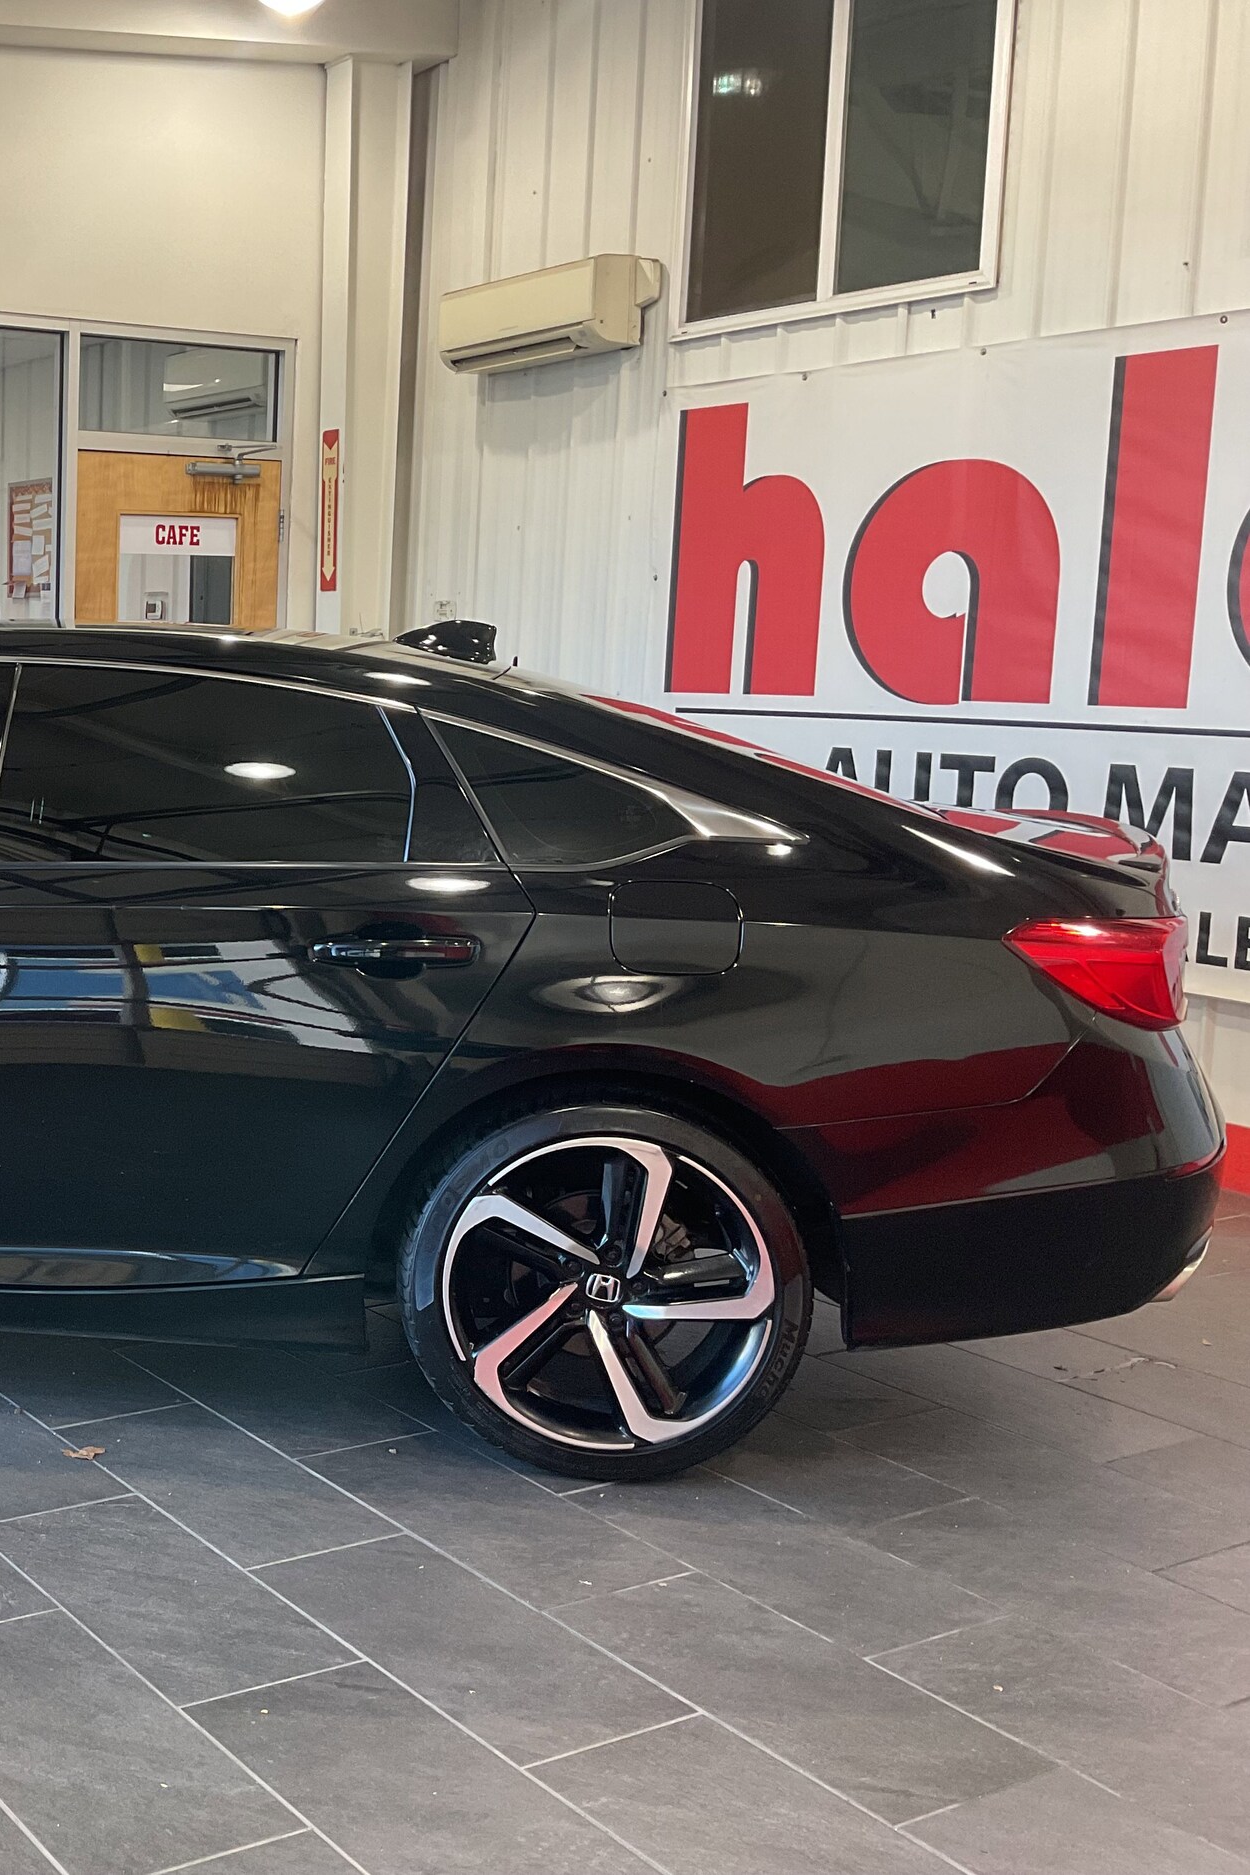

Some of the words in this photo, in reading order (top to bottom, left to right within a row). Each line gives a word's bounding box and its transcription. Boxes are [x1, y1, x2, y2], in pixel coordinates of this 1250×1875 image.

[324, 456, 336, 466] FIRE
[155, 524, 201, 546] CAFE
[664, 345, 1250, 708] hal
